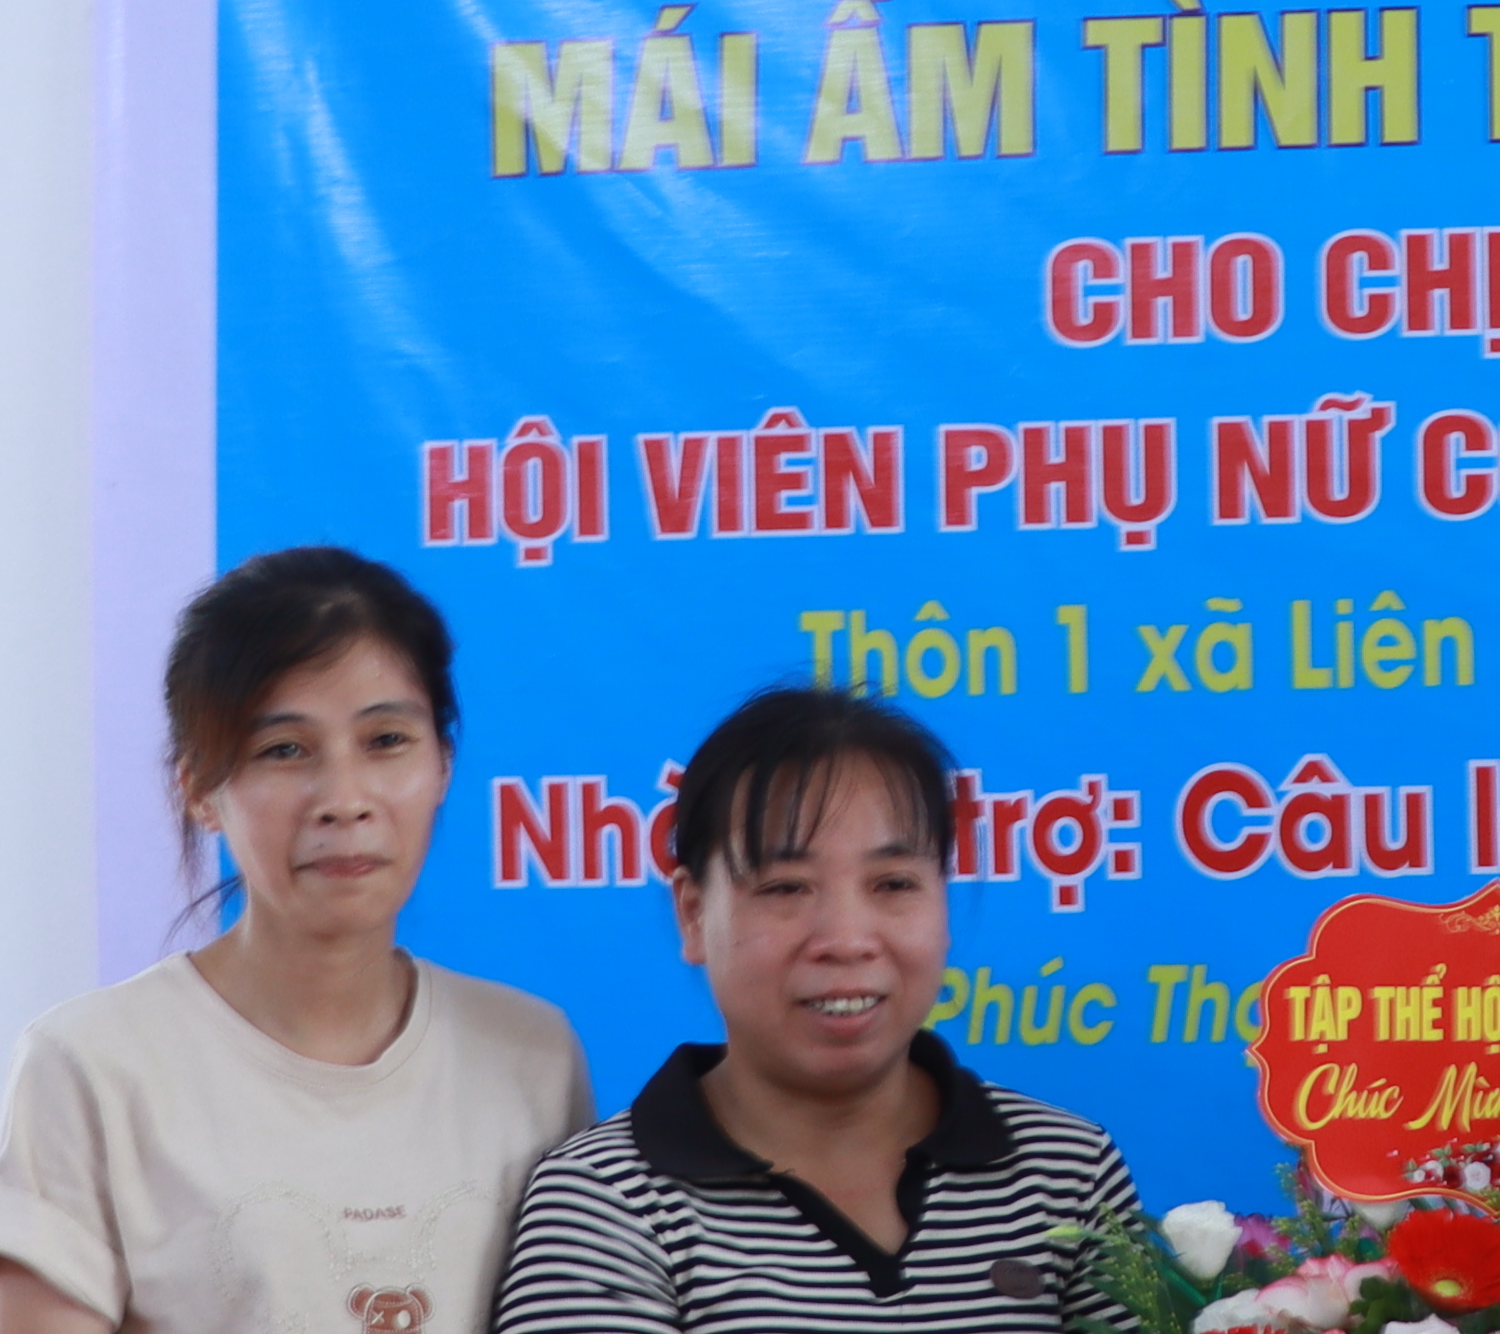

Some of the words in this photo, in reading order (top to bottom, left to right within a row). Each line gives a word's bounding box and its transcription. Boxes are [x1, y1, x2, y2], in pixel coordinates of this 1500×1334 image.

[489, 4, 758, 178] MÁI
[1045, 232, 1283, 349] CHO
[422, 414, 607, 567] HỘI
[637, 407, 905, 538] VIÊN
[937, 417, 1177, 551] PHỤ
[1212, 392, 1396, 526] NỮ
[800, 599, 1018, 699] Thôn
[1055, 604, 1090, 694] 1
[1134, 596, 1252, 692] xã
[1291, 590, 1472, 692] Liên
[1174, 753, 1430, 875] Câu
[1287, 974, 1362, 1054] TẬP
[1372, 963, 1447, 1042] THỂ
[1296, 1061, 1404, 1131] Chúc
